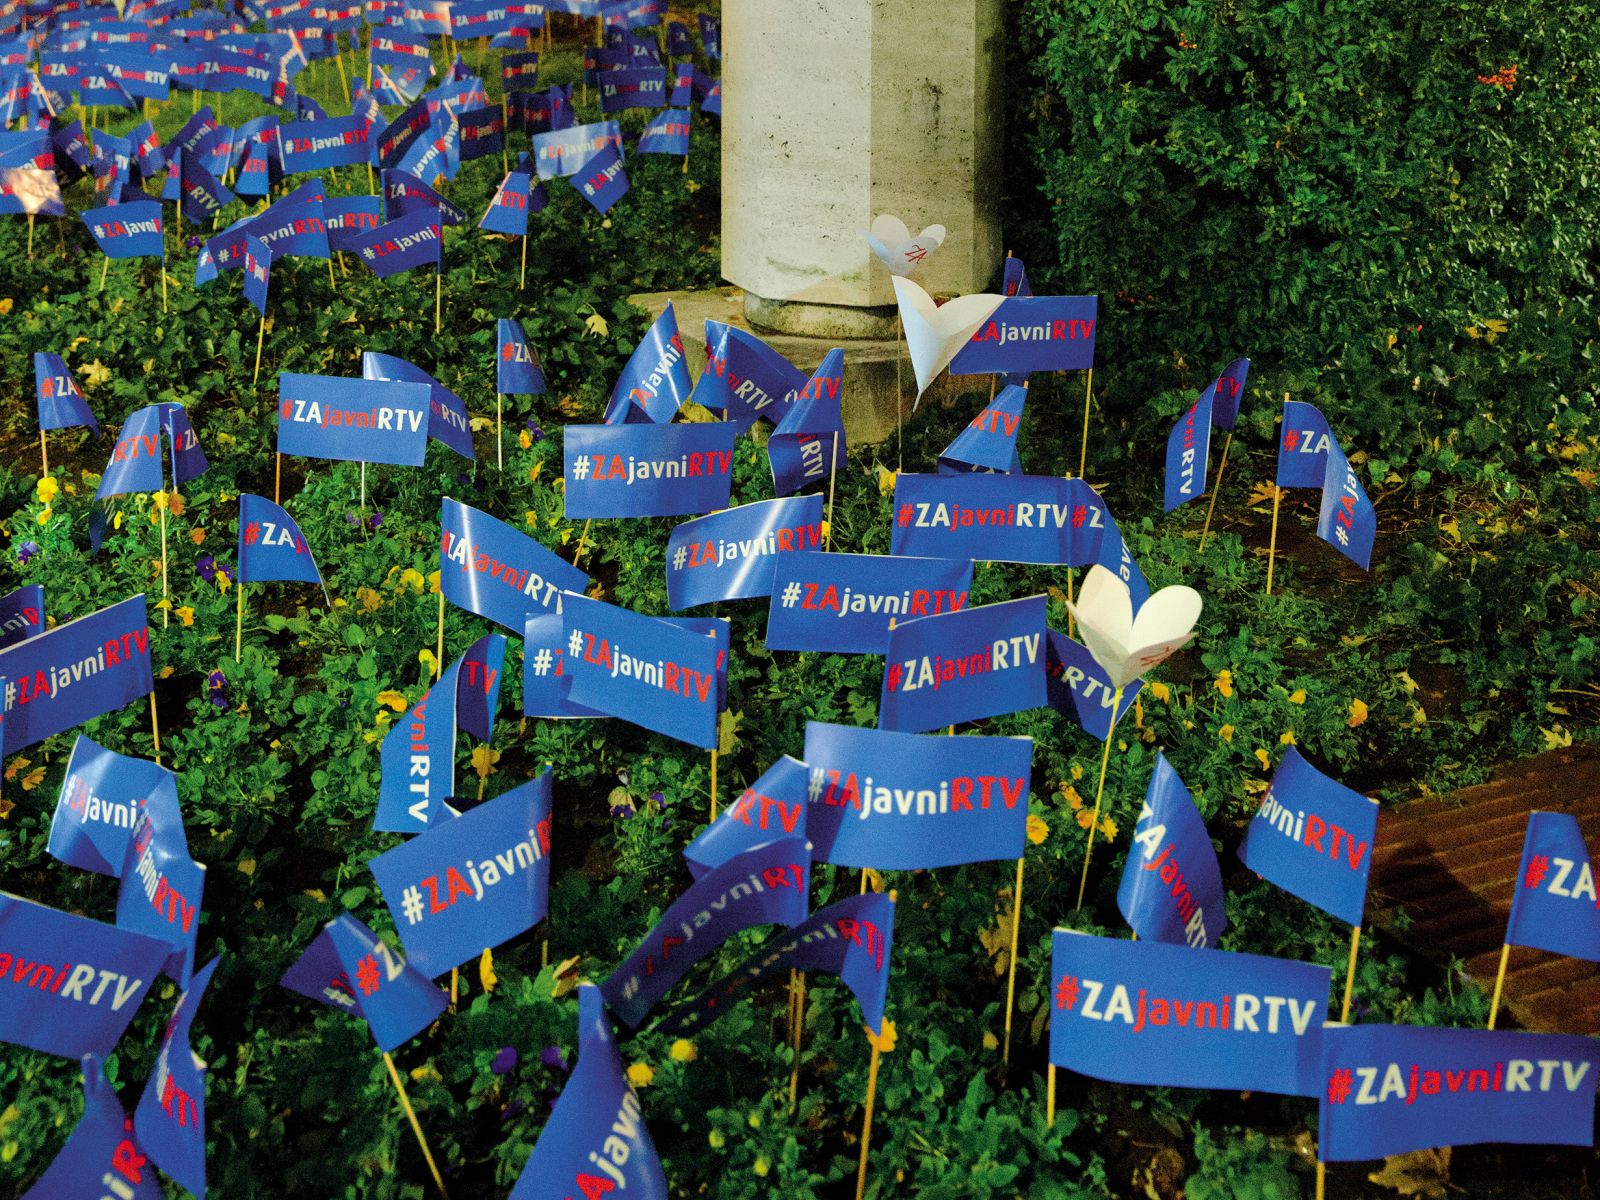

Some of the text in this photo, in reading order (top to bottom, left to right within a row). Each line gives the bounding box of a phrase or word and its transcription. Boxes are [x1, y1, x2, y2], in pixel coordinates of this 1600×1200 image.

[281, 399, 423, 433] #ZAjavniRTV
[573, 450, 733, 485] #ZAjavniRTV
[897, 502, 1067, 531] #ZAjavniRTV
[673, 523, 822, 571] #ZAjavniRTV
[782, 581, 968, 617] #ZAjavniRTV
[4, 625, 149, 712] #ZAjavniRTV
[569, 629, 712, 703] #ZAjavniRTV
[888, 633, 1040, 693] #ZAjavniRTV
[808, 767, 1025, 820] #ZAjavniRTV
[1056, 974, 1316, 1035] #ZAjavniRTV
[1328, 1059, 1590, 1105] #ZAjavniRTV
